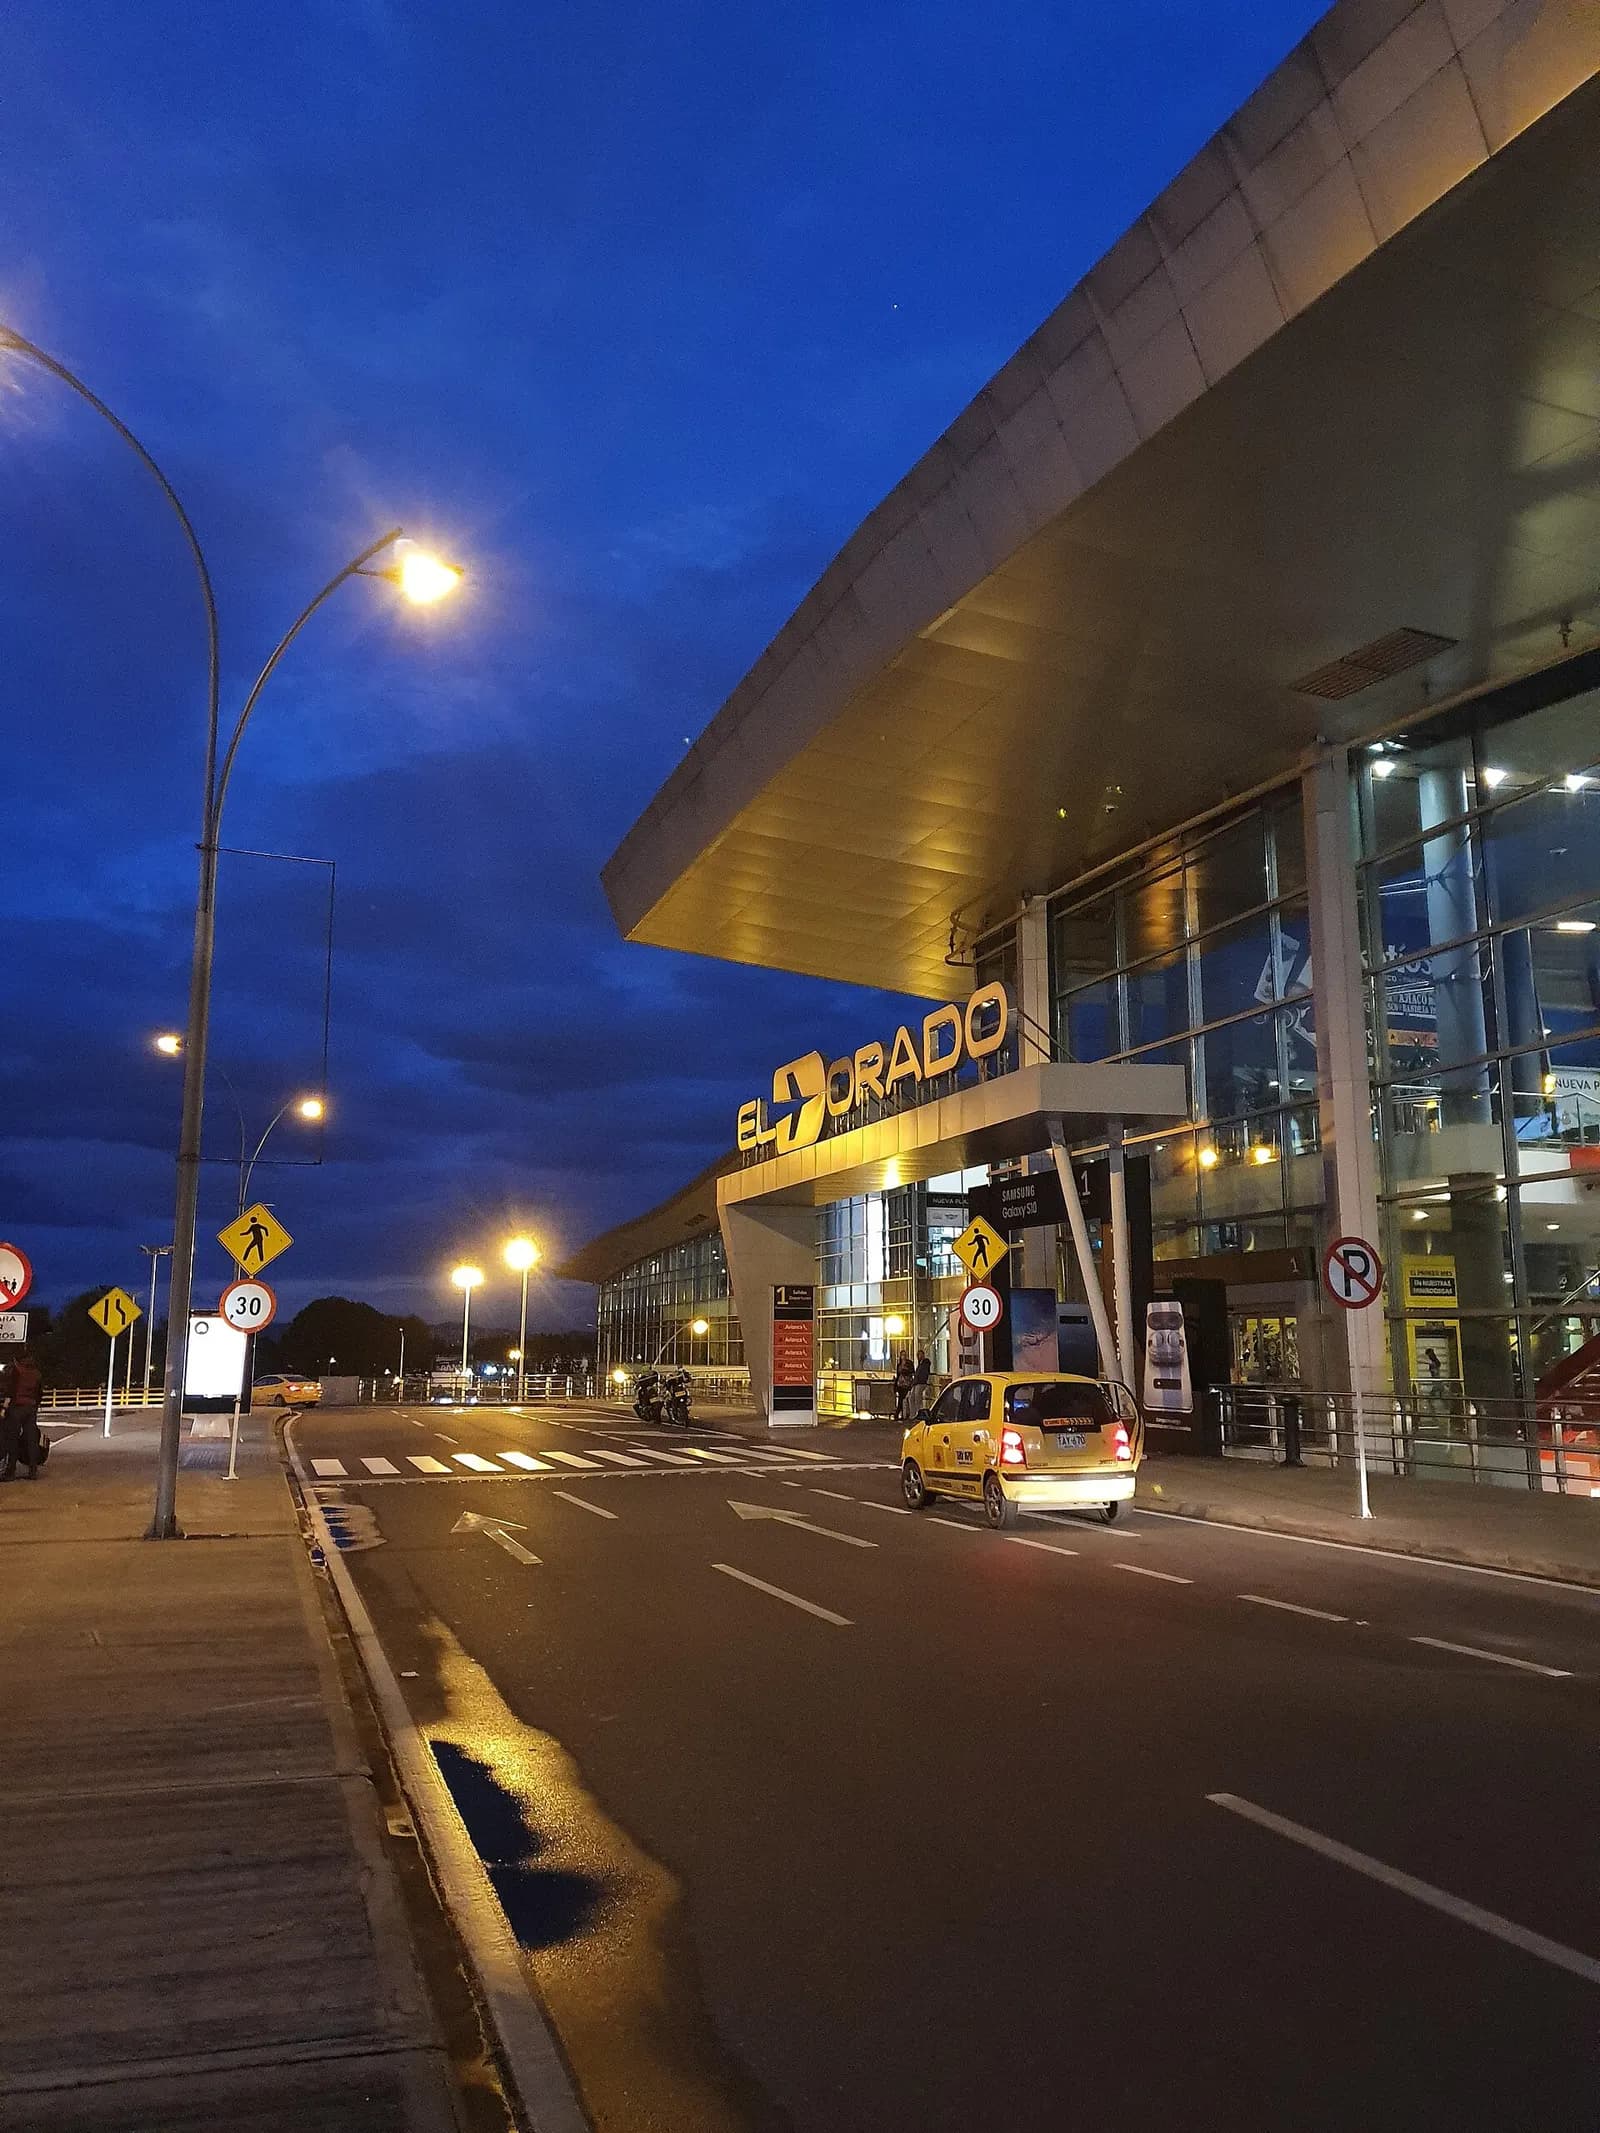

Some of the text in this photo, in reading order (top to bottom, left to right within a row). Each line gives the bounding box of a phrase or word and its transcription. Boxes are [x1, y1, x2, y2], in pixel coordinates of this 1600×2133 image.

[736, 980, 1008, 1155] EL DORADO
[1555, 1079, 1591, 1090] NUEVA
[1081, 1170, 1091, 1196] 1
[1002, 1184, 1035, 1202] SAMSUNG
[1002, 1201, 1038, 1219] Galaxy S10
[1290, 1256, 1298, 1272] 1
[1343, 1249, 1370, 1296] P
[776, 1286, 789, 1305] 1
[235, 1296, 261, 1316] 30
[971, 1298, 992, 1316] 30
